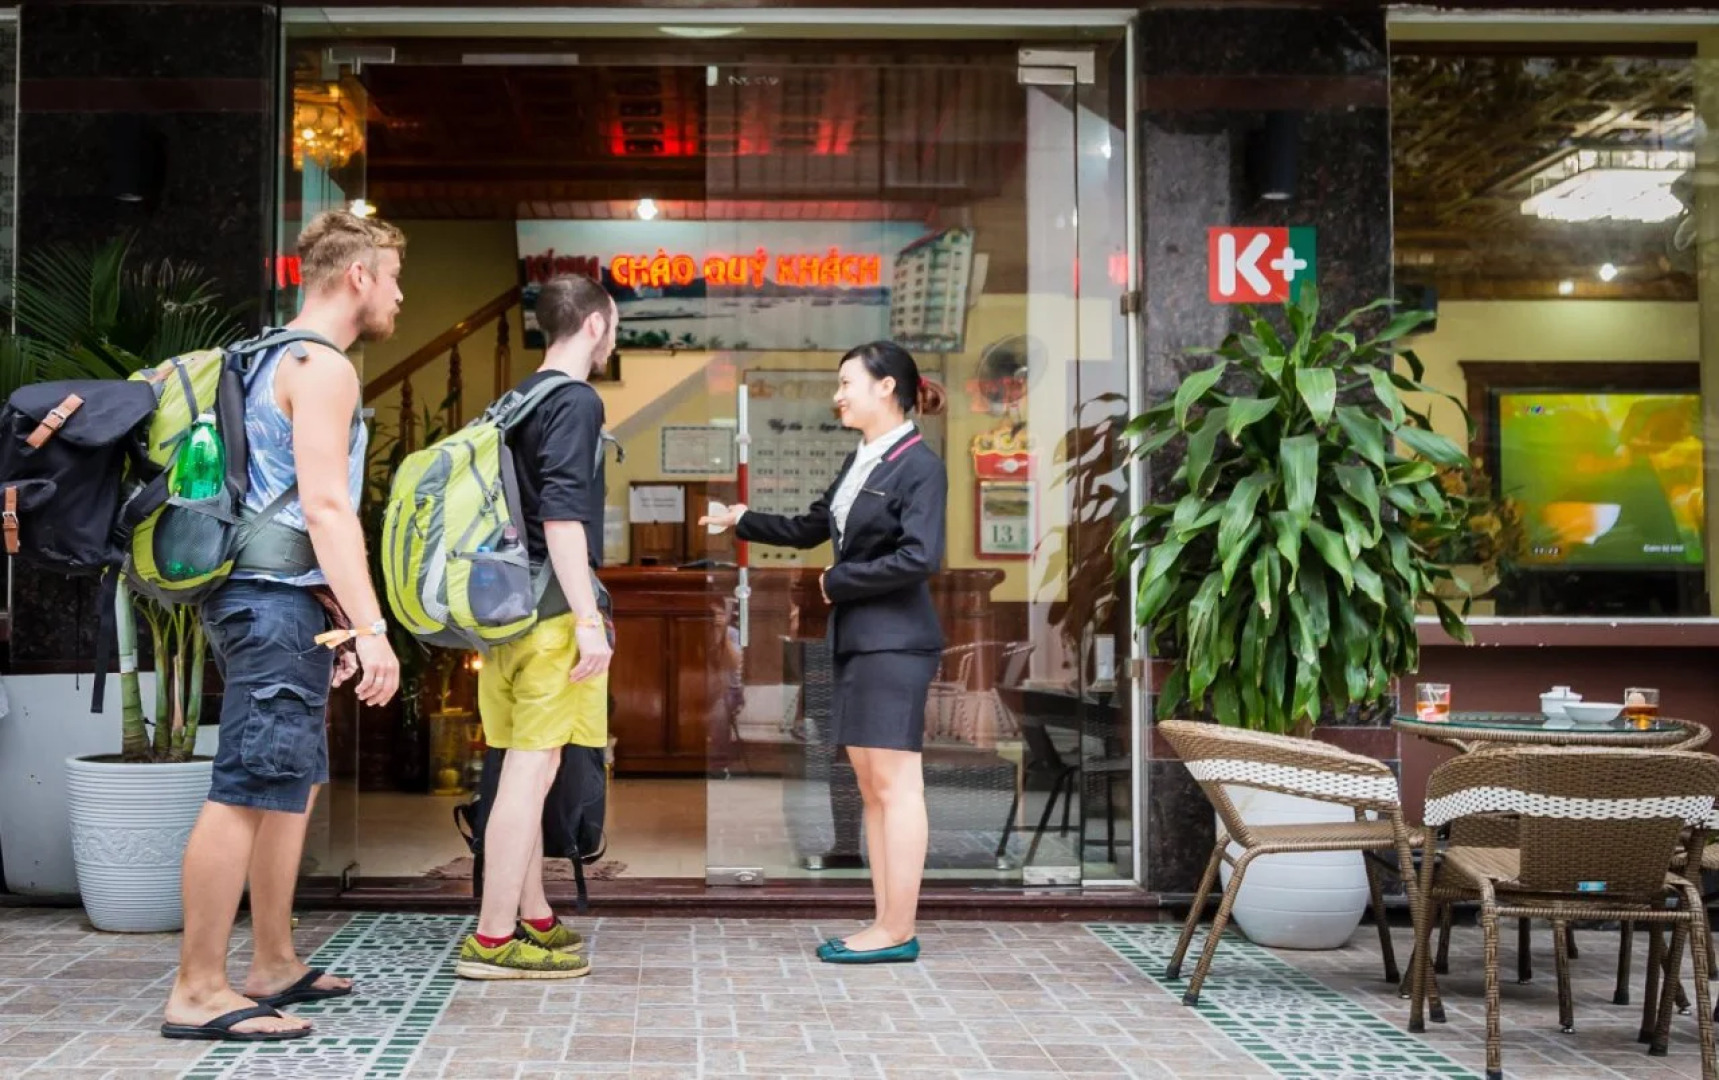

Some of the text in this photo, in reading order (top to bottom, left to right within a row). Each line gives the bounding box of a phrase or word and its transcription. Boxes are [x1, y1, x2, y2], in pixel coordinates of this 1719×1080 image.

[703, 246, 768, 290] QUÝ
[775, 247, 881, 288] KHÁCH
[1218, 233, 1307, 296] K+
[993, 524, 1013, 543] 13
